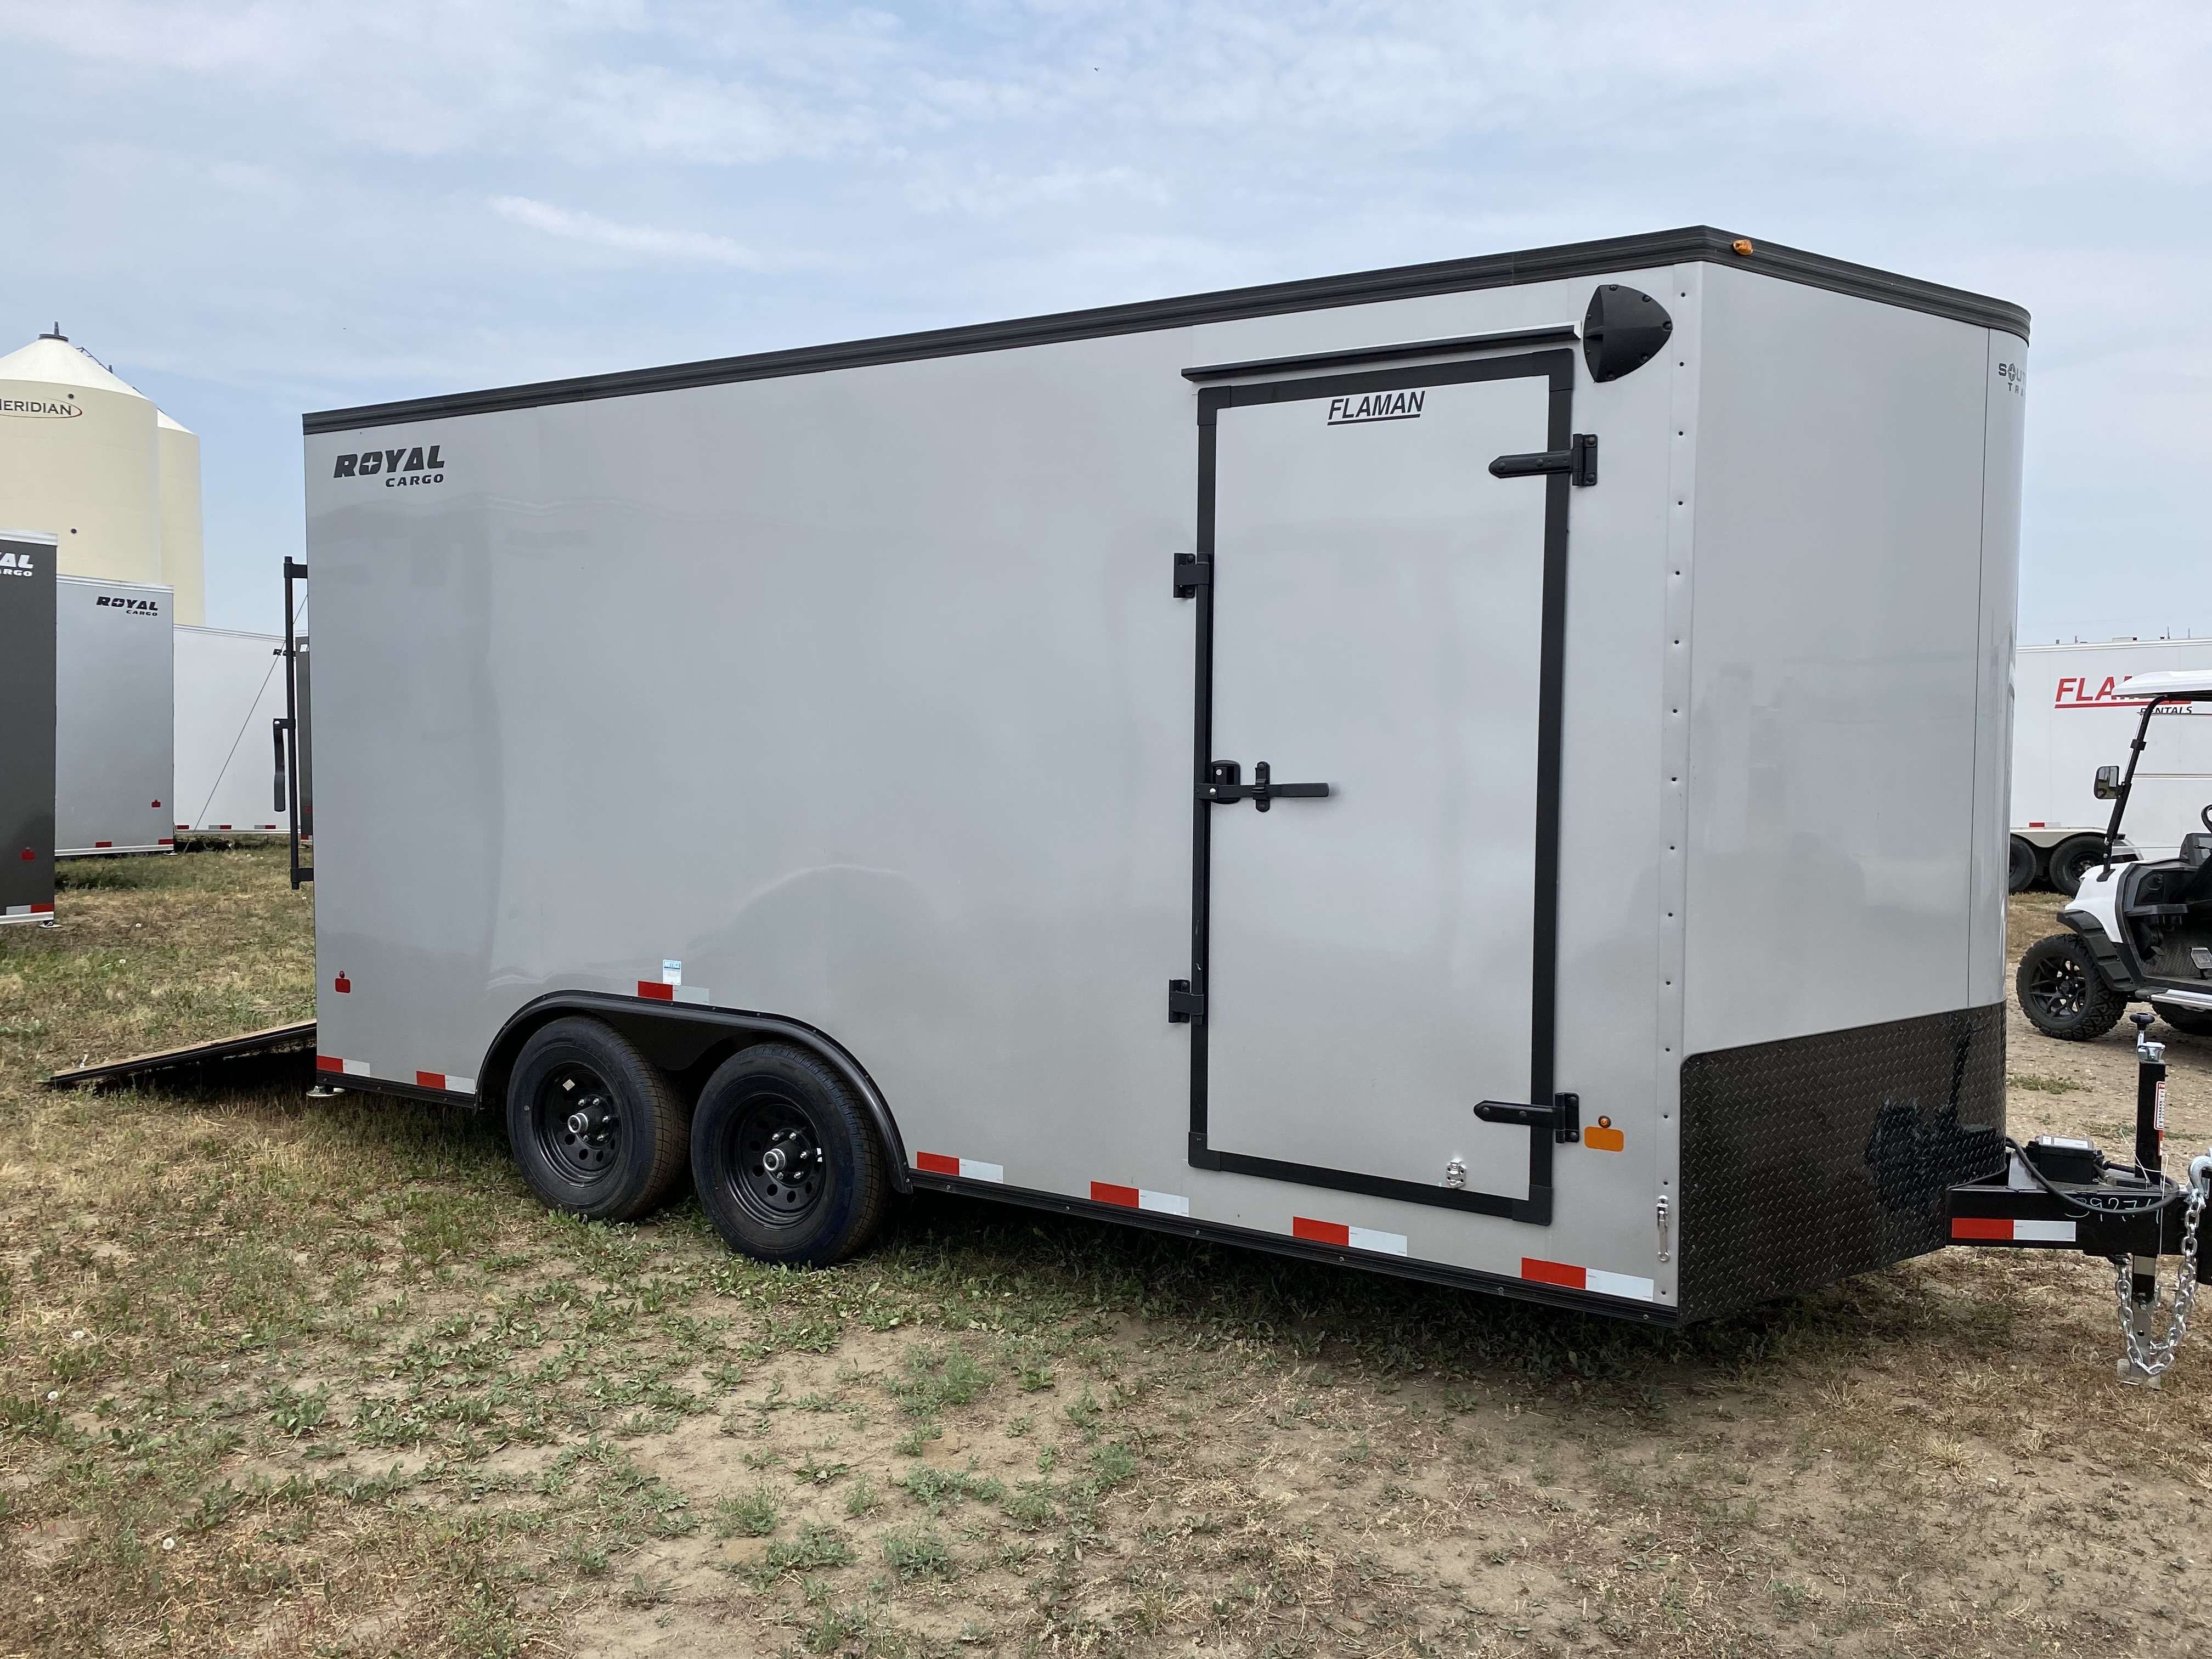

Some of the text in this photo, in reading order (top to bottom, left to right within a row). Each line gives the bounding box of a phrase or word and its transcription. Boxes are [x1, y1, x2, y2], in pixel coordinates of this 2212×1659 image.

[0, 399, 71, 415] ERIDIAN
[1328, 391, 1425, 420] FLAMAN
[334, 445, 445, 478] ROYAL
[385, 473, 443, 487] CARGO
[0, 552, 33, 569] AL
[0, 568, 32, 577] RGO
[96, 596, 158, 611] ROYAL
[2055, 676, 2132, 702] FLA
[2140, 706, 2193, 714] RNTALS
